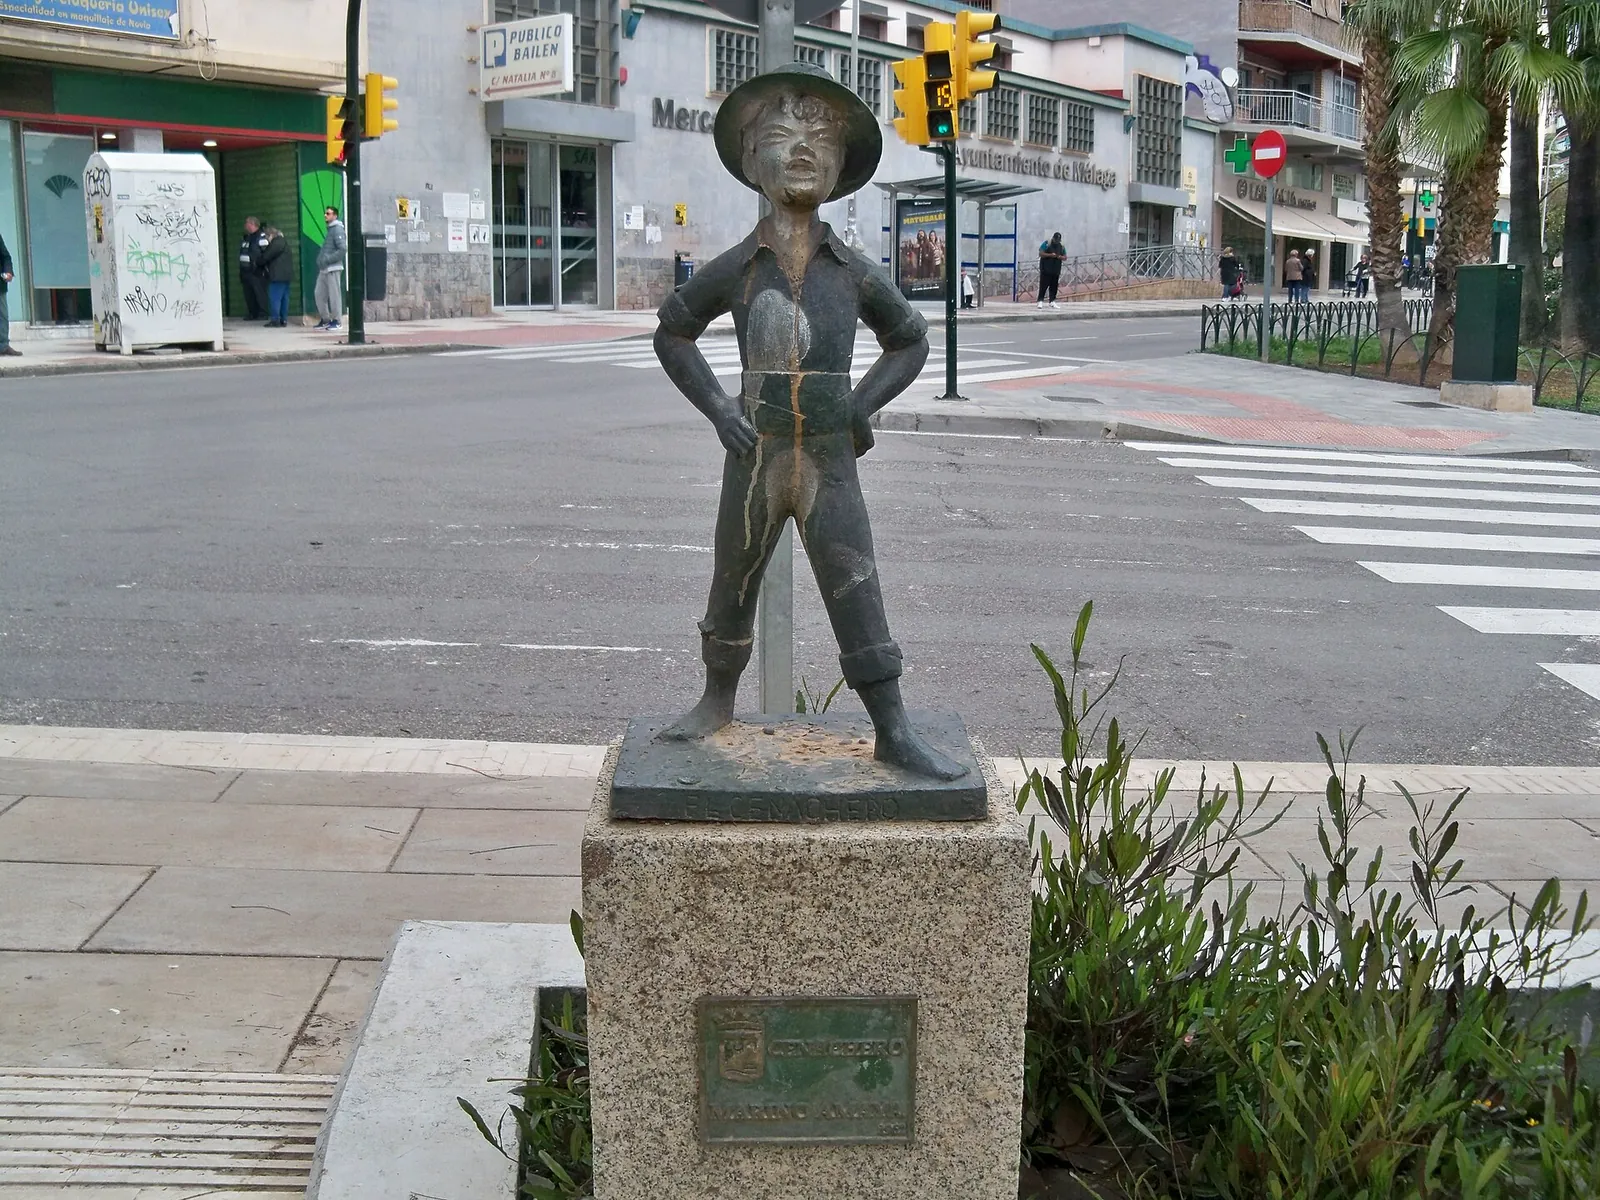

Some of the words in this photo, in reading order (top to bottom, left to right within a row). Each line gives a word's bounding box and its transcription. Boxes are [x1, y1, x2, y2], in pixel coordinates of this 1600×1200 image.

[129, 0, 171, 19] Unisex
[71, 13, 114, 25] maquillaje
[117, 18, 127, 26] de
[129, 19, 151, 29] Novia
[510, 25, 562, 44] PUBLICO
[514, 43, 559, 61] BAILEN
[503, 72, 537, 84] NATALIA
[937, 84, 952, 107] 15
[1053, 158, 1070, 180] de
[1072, 161, 1117, 191] Málaga
[1249, 183, 1297, 206] FARACIA
